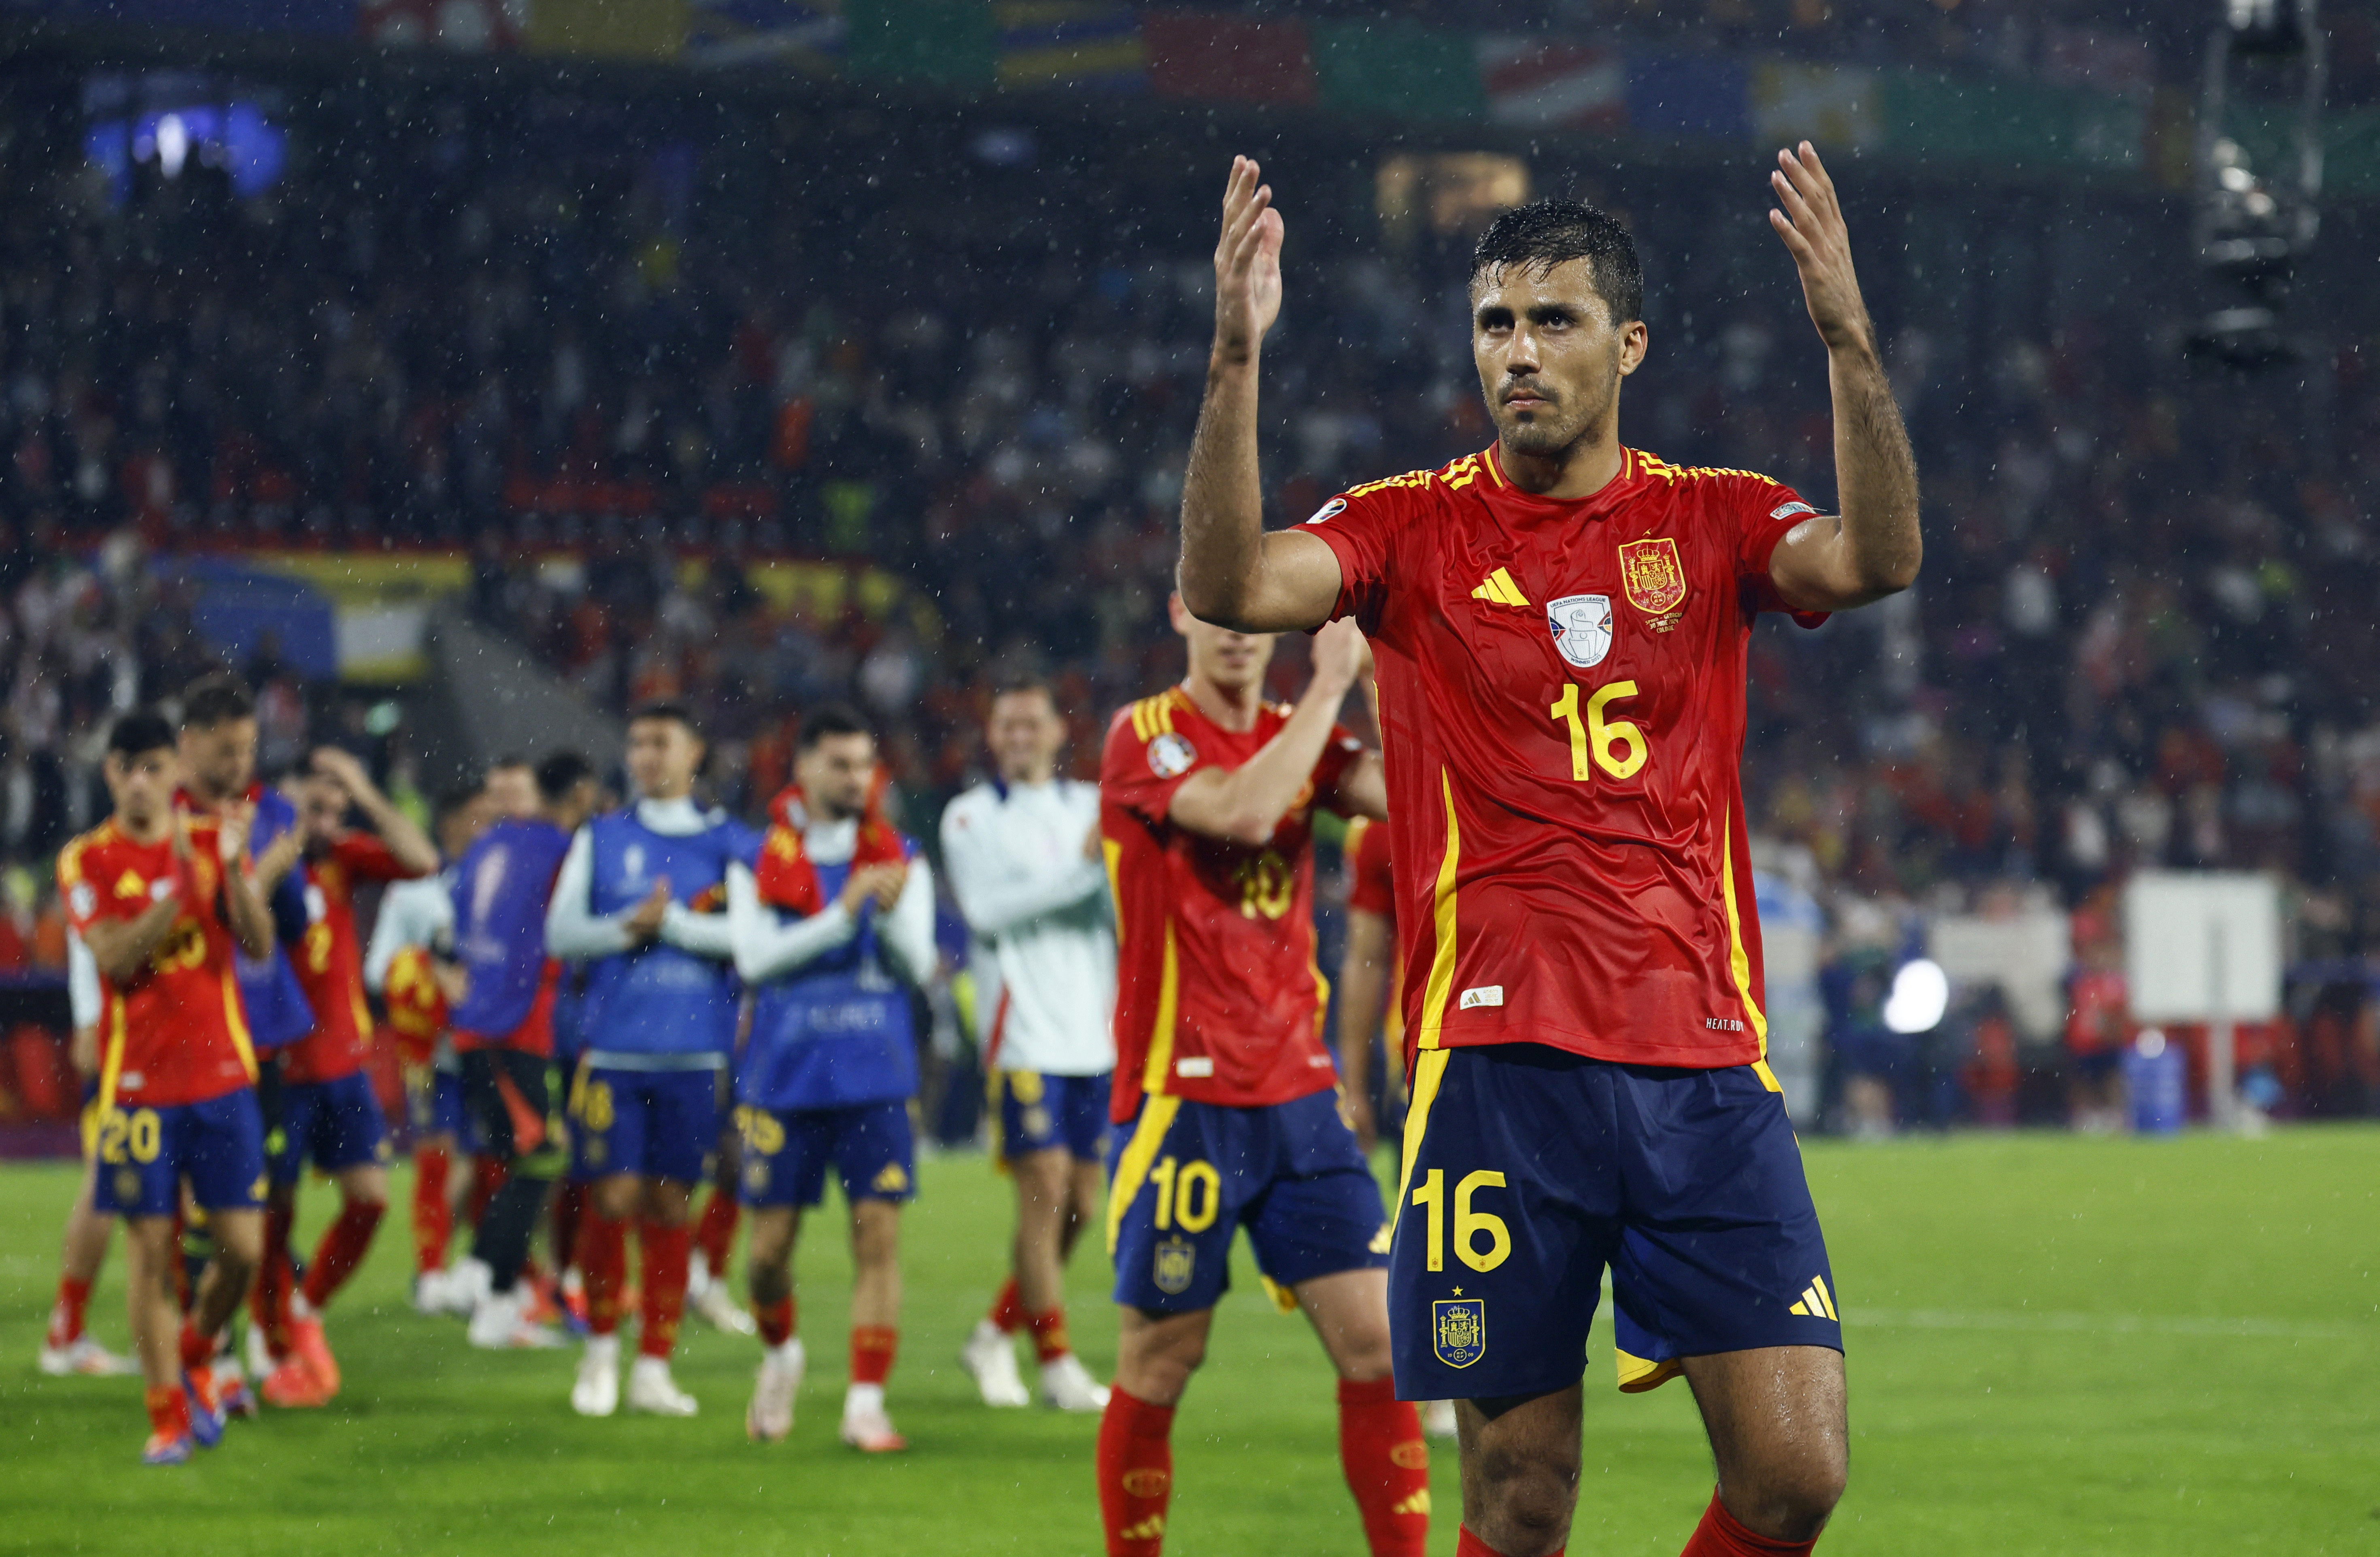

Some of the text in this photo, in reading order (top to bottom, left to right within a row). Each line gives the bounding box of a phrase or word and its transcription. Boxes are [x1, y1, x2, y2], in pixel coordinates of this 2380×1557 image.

[1591, 654, 1602, 663] 2023
[1551, 680, 1648, 781] 16
[1232, 852, 1292, 920] 10
[1706, 1018, 1744, 1032] HEAT.RDY
[101, 1107, 162, 1164] 20
[1150, 1155, 1221, 1233] 10
[1412, 1169, 1511, 1272] 16
